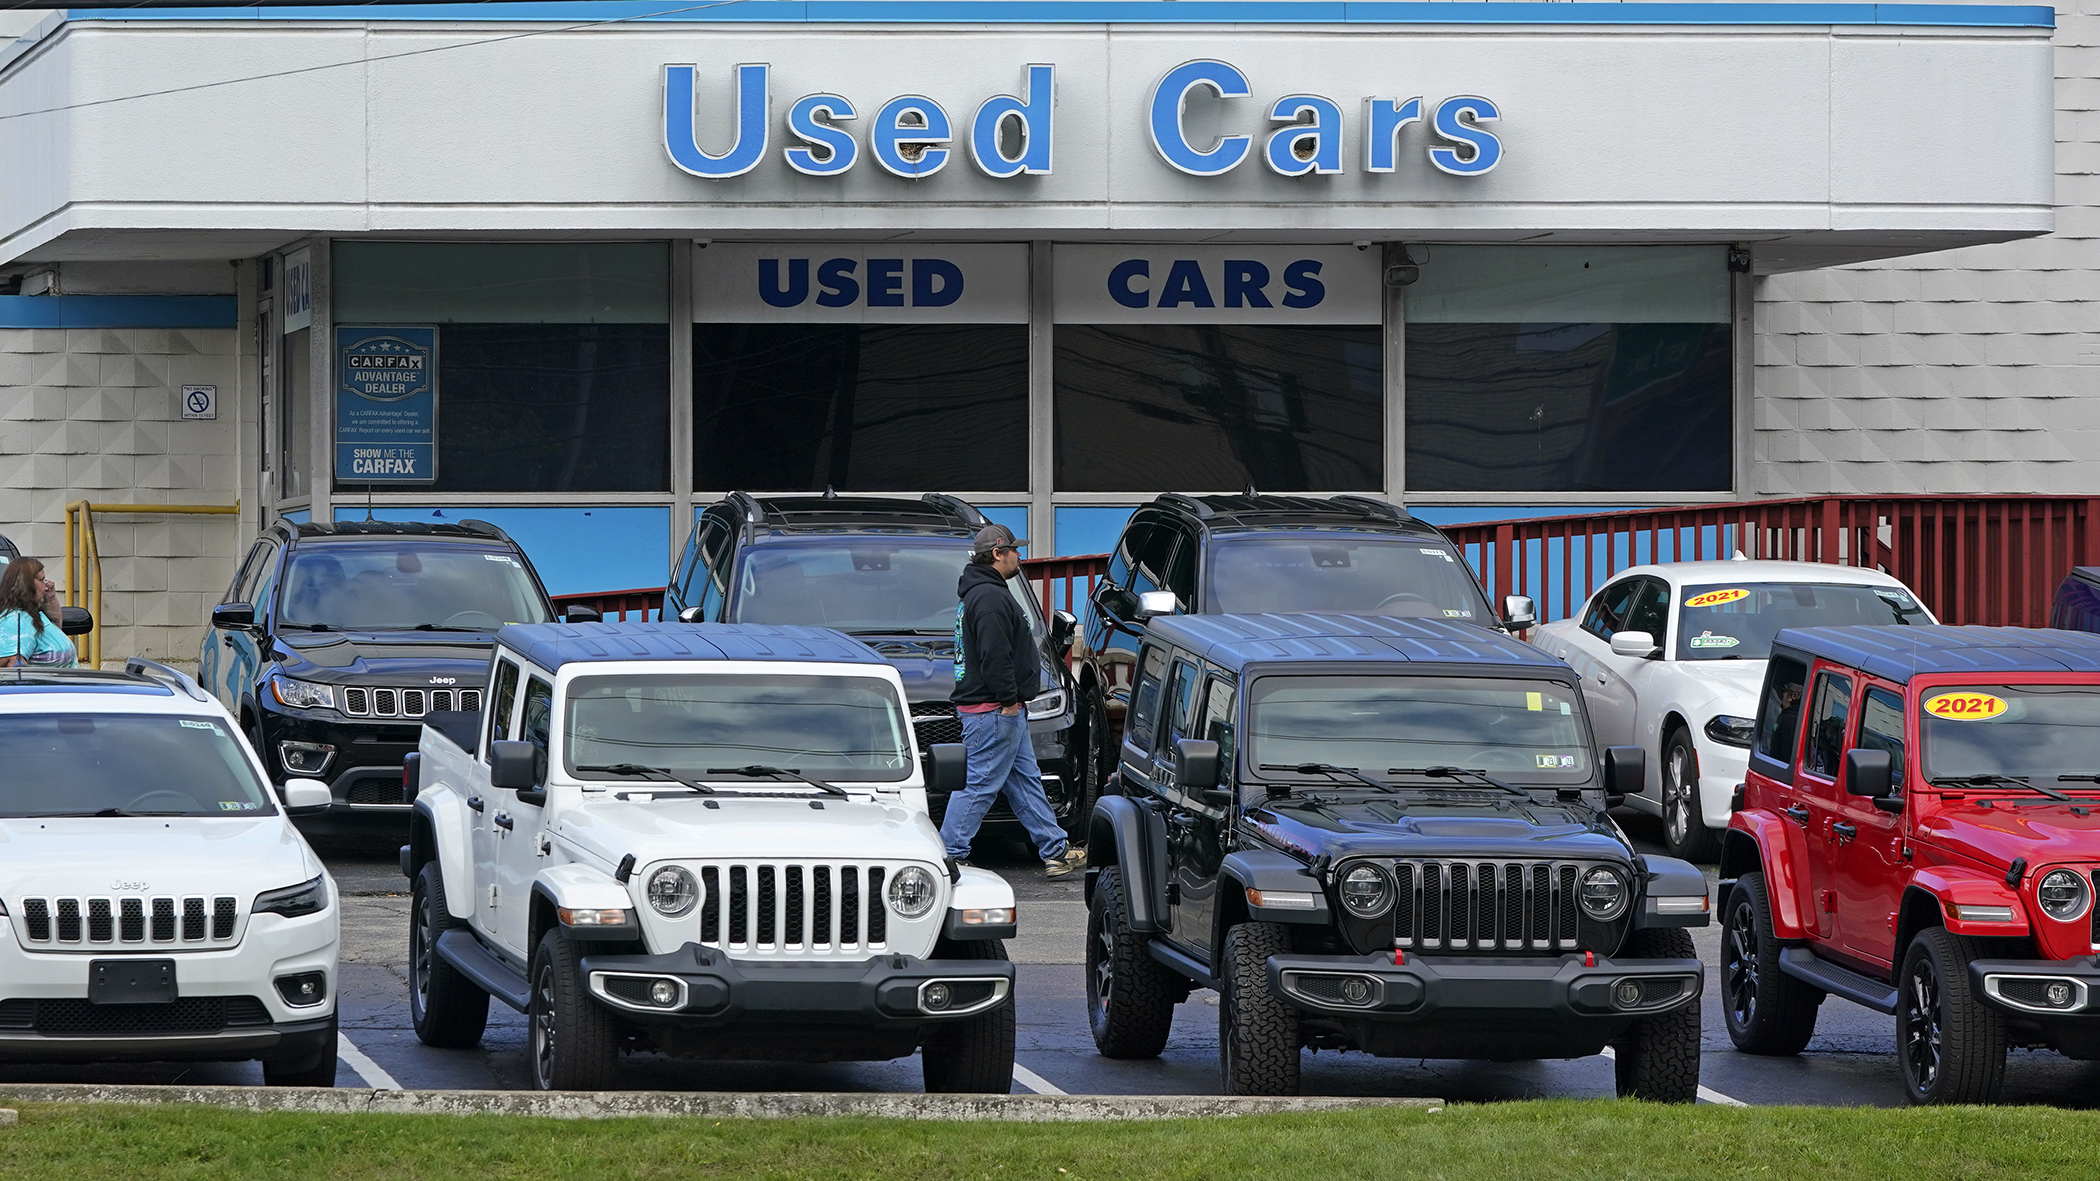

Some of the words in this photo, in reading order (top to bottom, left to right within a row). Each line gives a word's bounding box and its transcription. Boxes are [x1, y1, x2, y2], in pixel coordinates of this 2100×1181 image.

[662, 61, 1057, 179] Used
[1149, 58, 1504, 178] Cars
[286, 266, 300, 317] USED
[302, 262, 310, 312] CA
[757, 257, 965, 309] USED
[1106, 258, 1326, 310] CARS
[350, 356, 420, 369] CARFAX
[354, 371, 417, 382] ADVANTAGE
[365, 383, 406, 393] DEALER
[354, 449, 382, 458] SHOW
[384, 449, 396, 458] ME
[399, 449, 414, 458] THE
[353, 459, 415, 474] CARFAX
[1693, 590, 1740, 606] 2021
[429, 676, 456, 686] Jeep
[1934, 698, 1995, 713] 2021
[1257, 820, 1319, 857] RUBICON
[110, 879, 150, 892] Jeep
